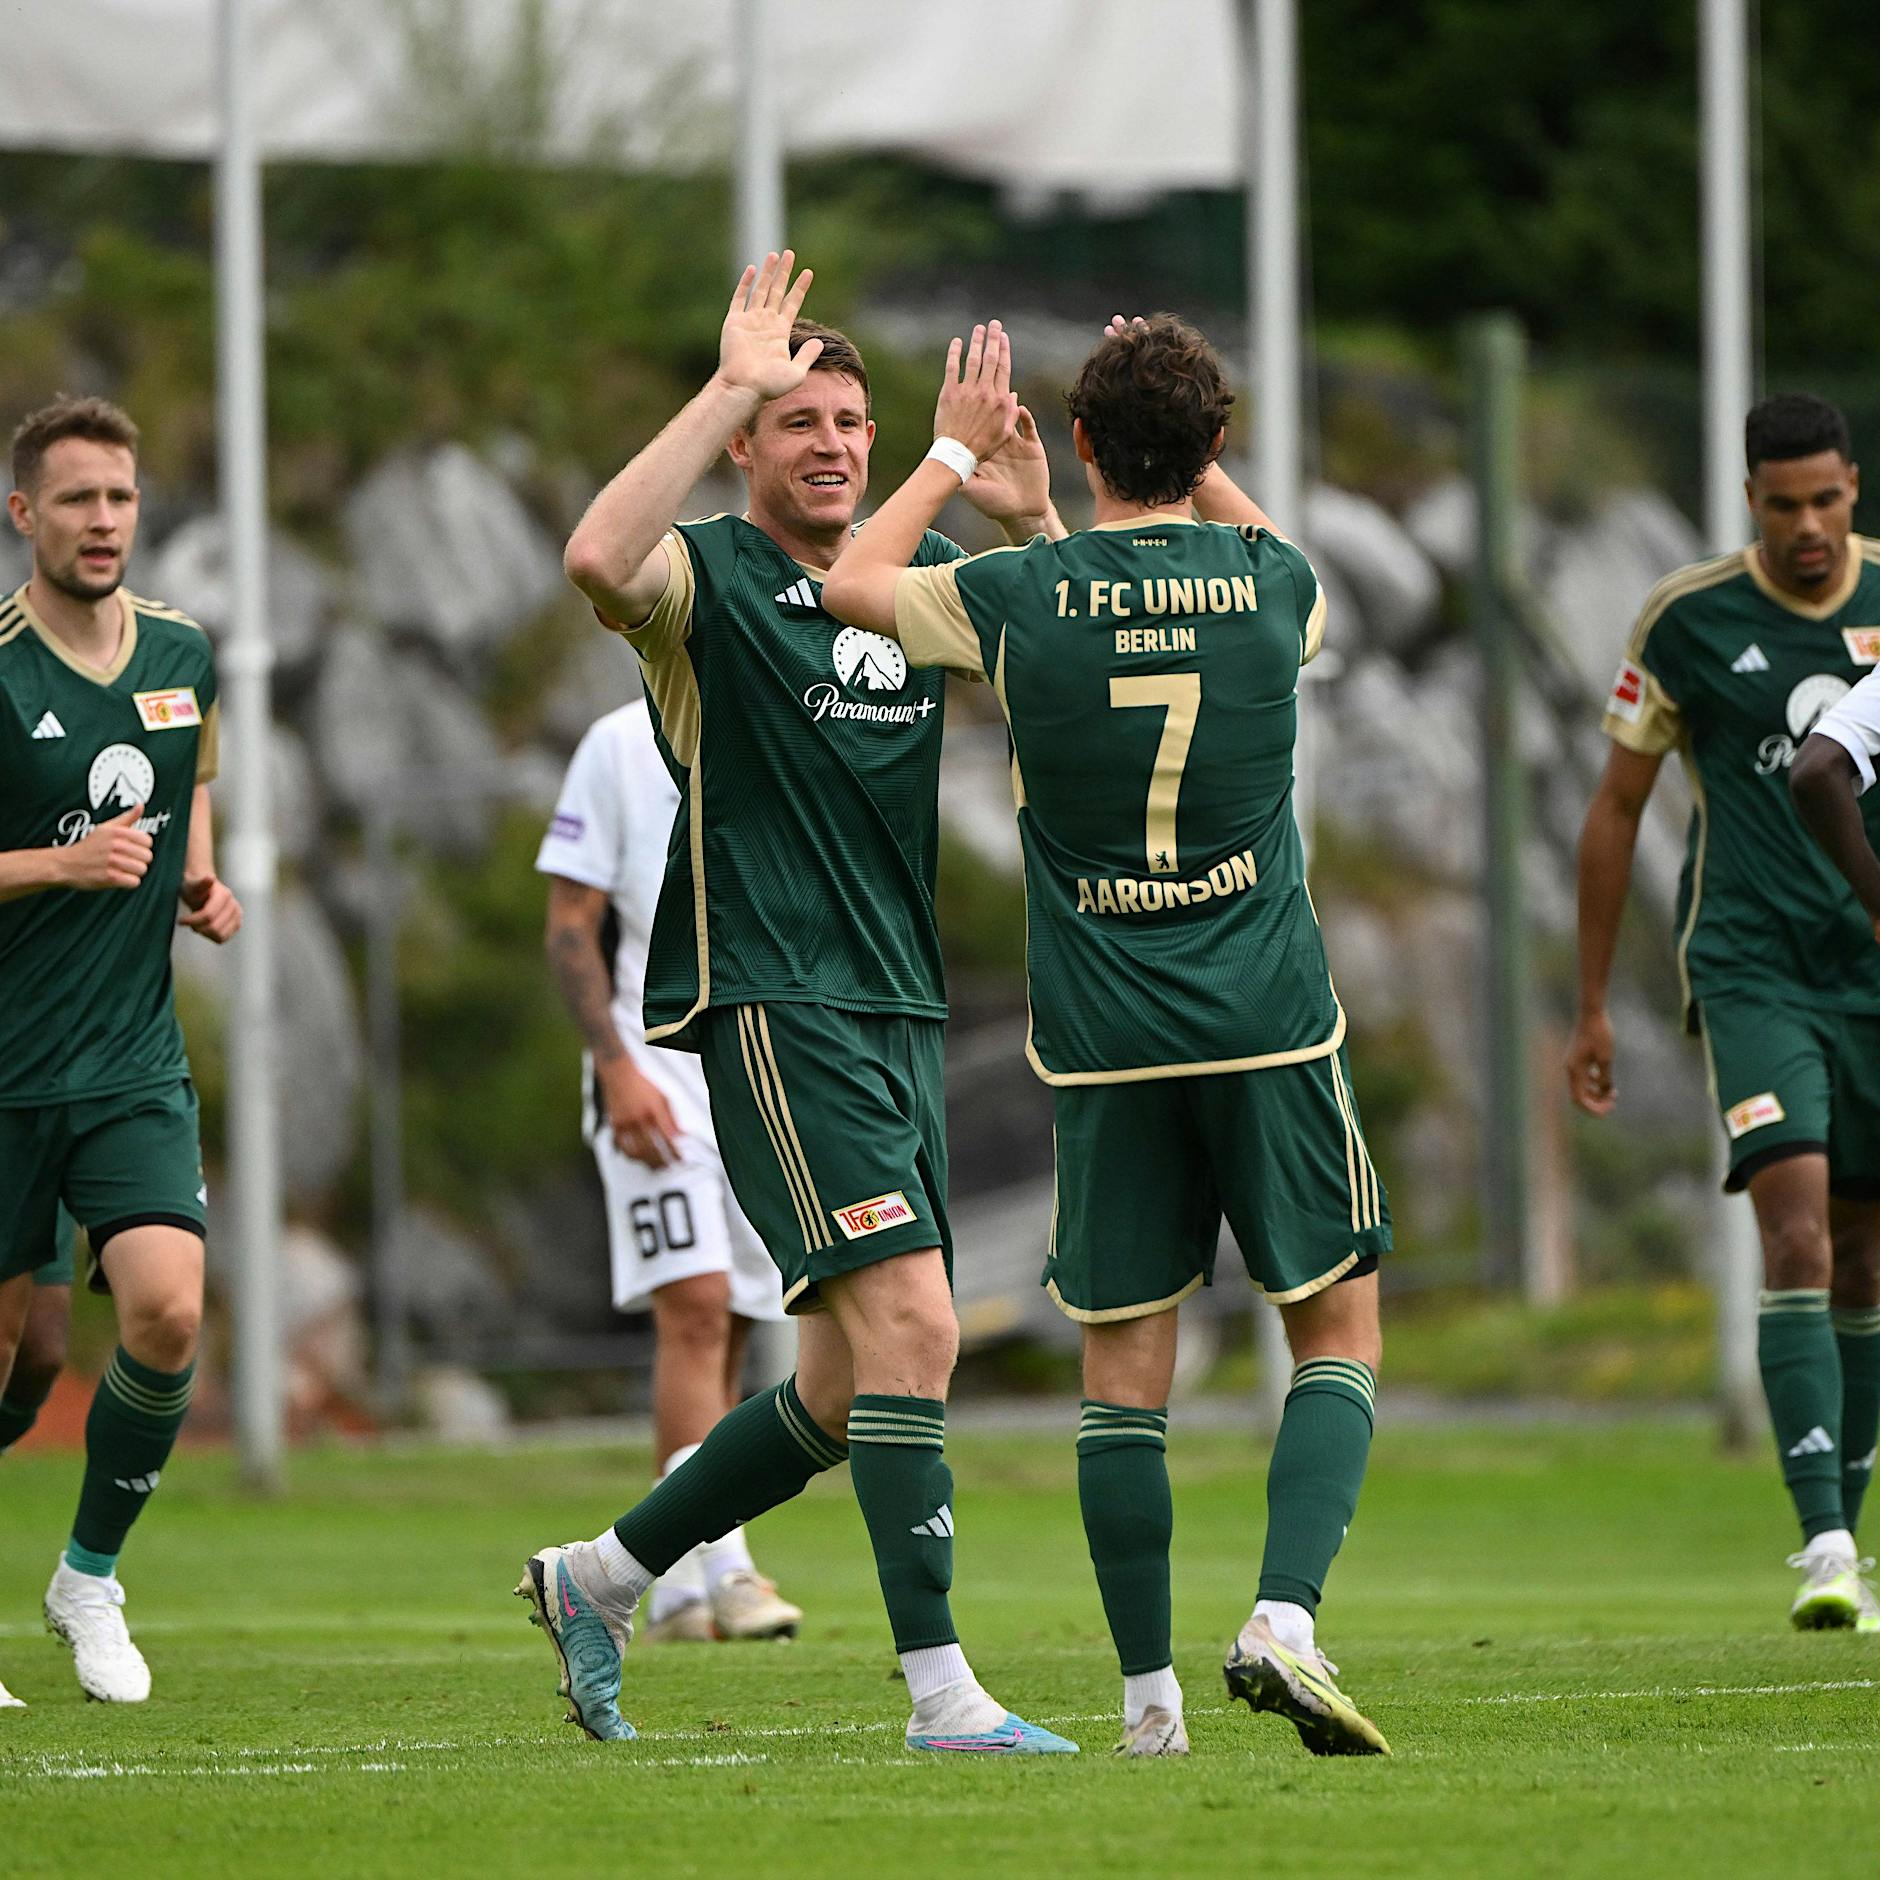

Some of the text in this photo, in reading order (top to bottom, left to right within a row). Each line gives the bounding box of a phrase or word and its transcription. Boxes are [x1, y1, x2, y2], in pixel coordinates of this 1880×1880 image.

[1055, 575, 1258, 618] 1. FC UNION
[1115, 627, 1196, 654] BERLIN
[1109, 672, 1201, 874] 7
[1076, 850, 1258, 914] AARONSON
[877, 1204, 907, 1222] UNION
